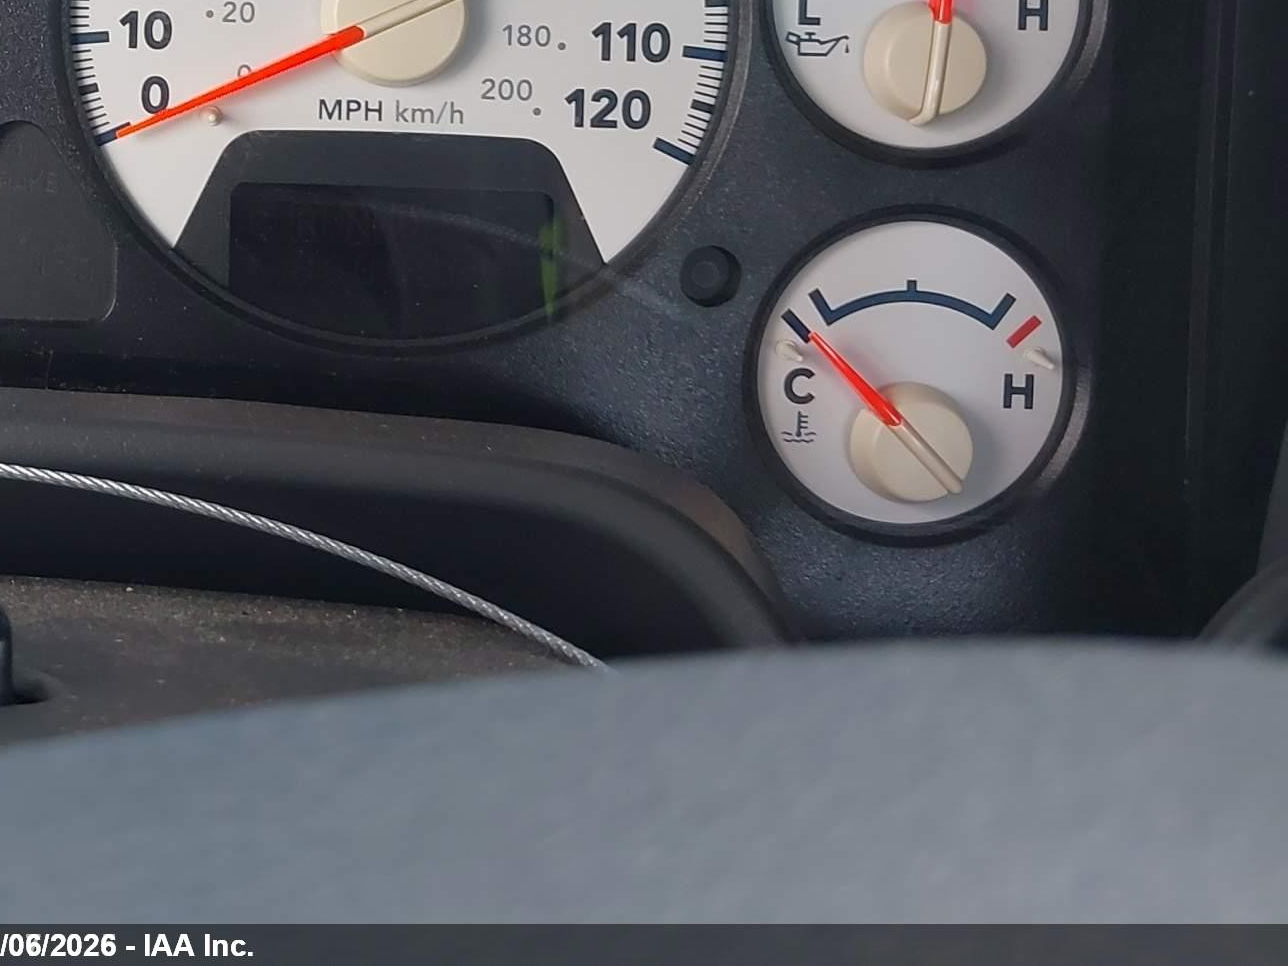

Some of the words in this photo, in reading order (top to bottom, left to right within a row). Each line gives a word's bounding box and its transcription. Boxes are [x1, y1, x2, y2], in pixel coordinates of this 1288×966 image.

[119, 10, 173, 50] 10
[221, 0, 256, 24] 20
[502, 24, 551, 48] 180
[591, 22, 671, 64] 110
[140, 75, 170, 115] 0
[480, 78, 533, 102] 200
[318, 98, 383, 122] MPH
[395, 99, 464, 125] km/h
[564, 88, 652, 130] 120
[783, 367, 816, 405] C
[1002, 373, 1035, 410] H
